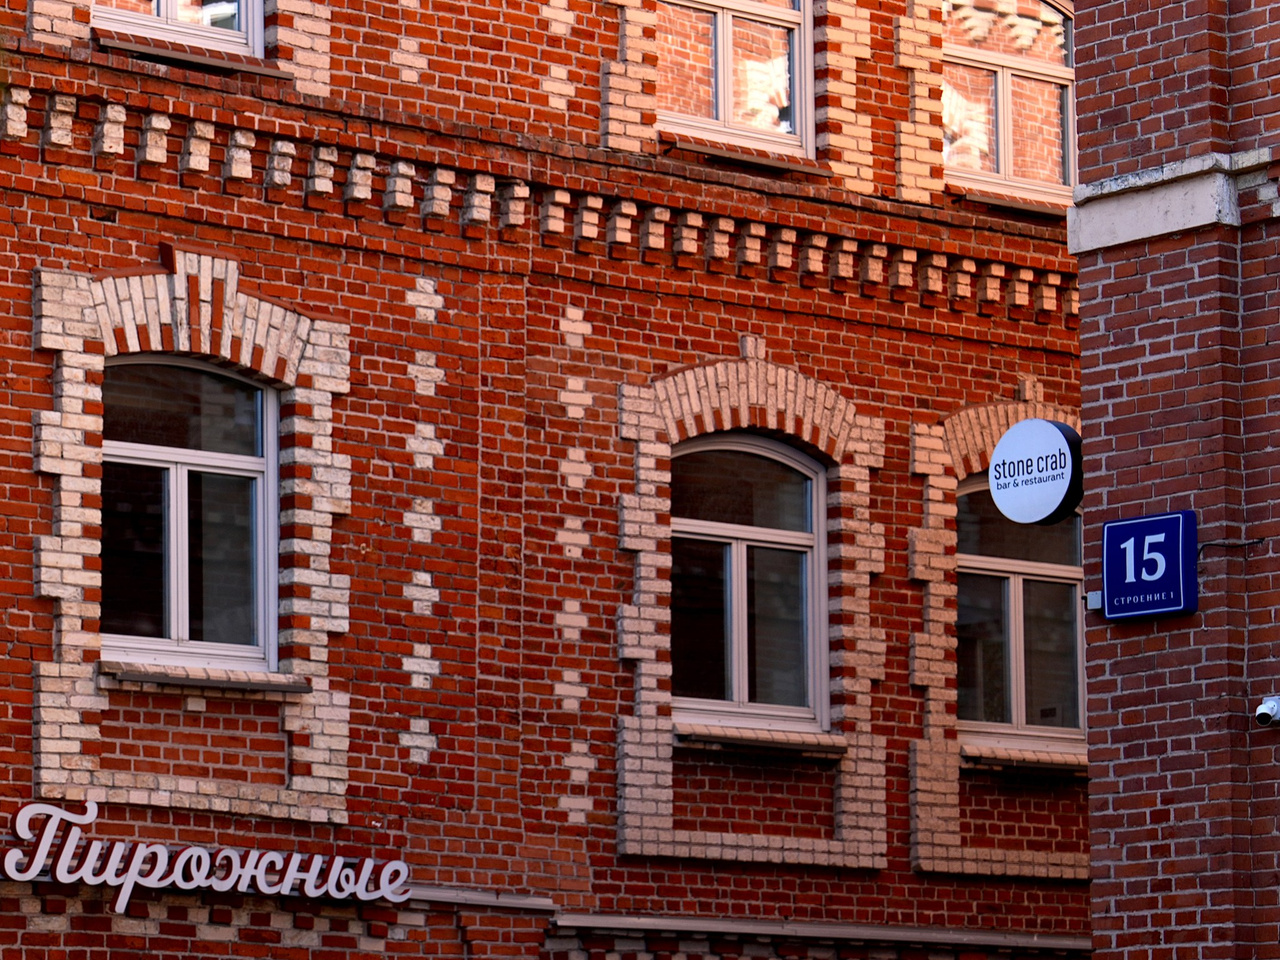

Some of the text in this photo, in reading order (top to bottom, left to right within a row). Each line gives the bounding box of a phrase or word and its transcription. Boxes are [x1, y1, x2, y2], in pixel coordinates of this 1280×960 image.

[994, 449, 1067, 480] stone crab
[996, 472, 1065, 490] bar & restaurant
[1120, 533, 1166, 583] 15
[1114, 591, 1174, 606] СТРОЕНИЕ 1
[1, 800, 411, 914] Пирожные
